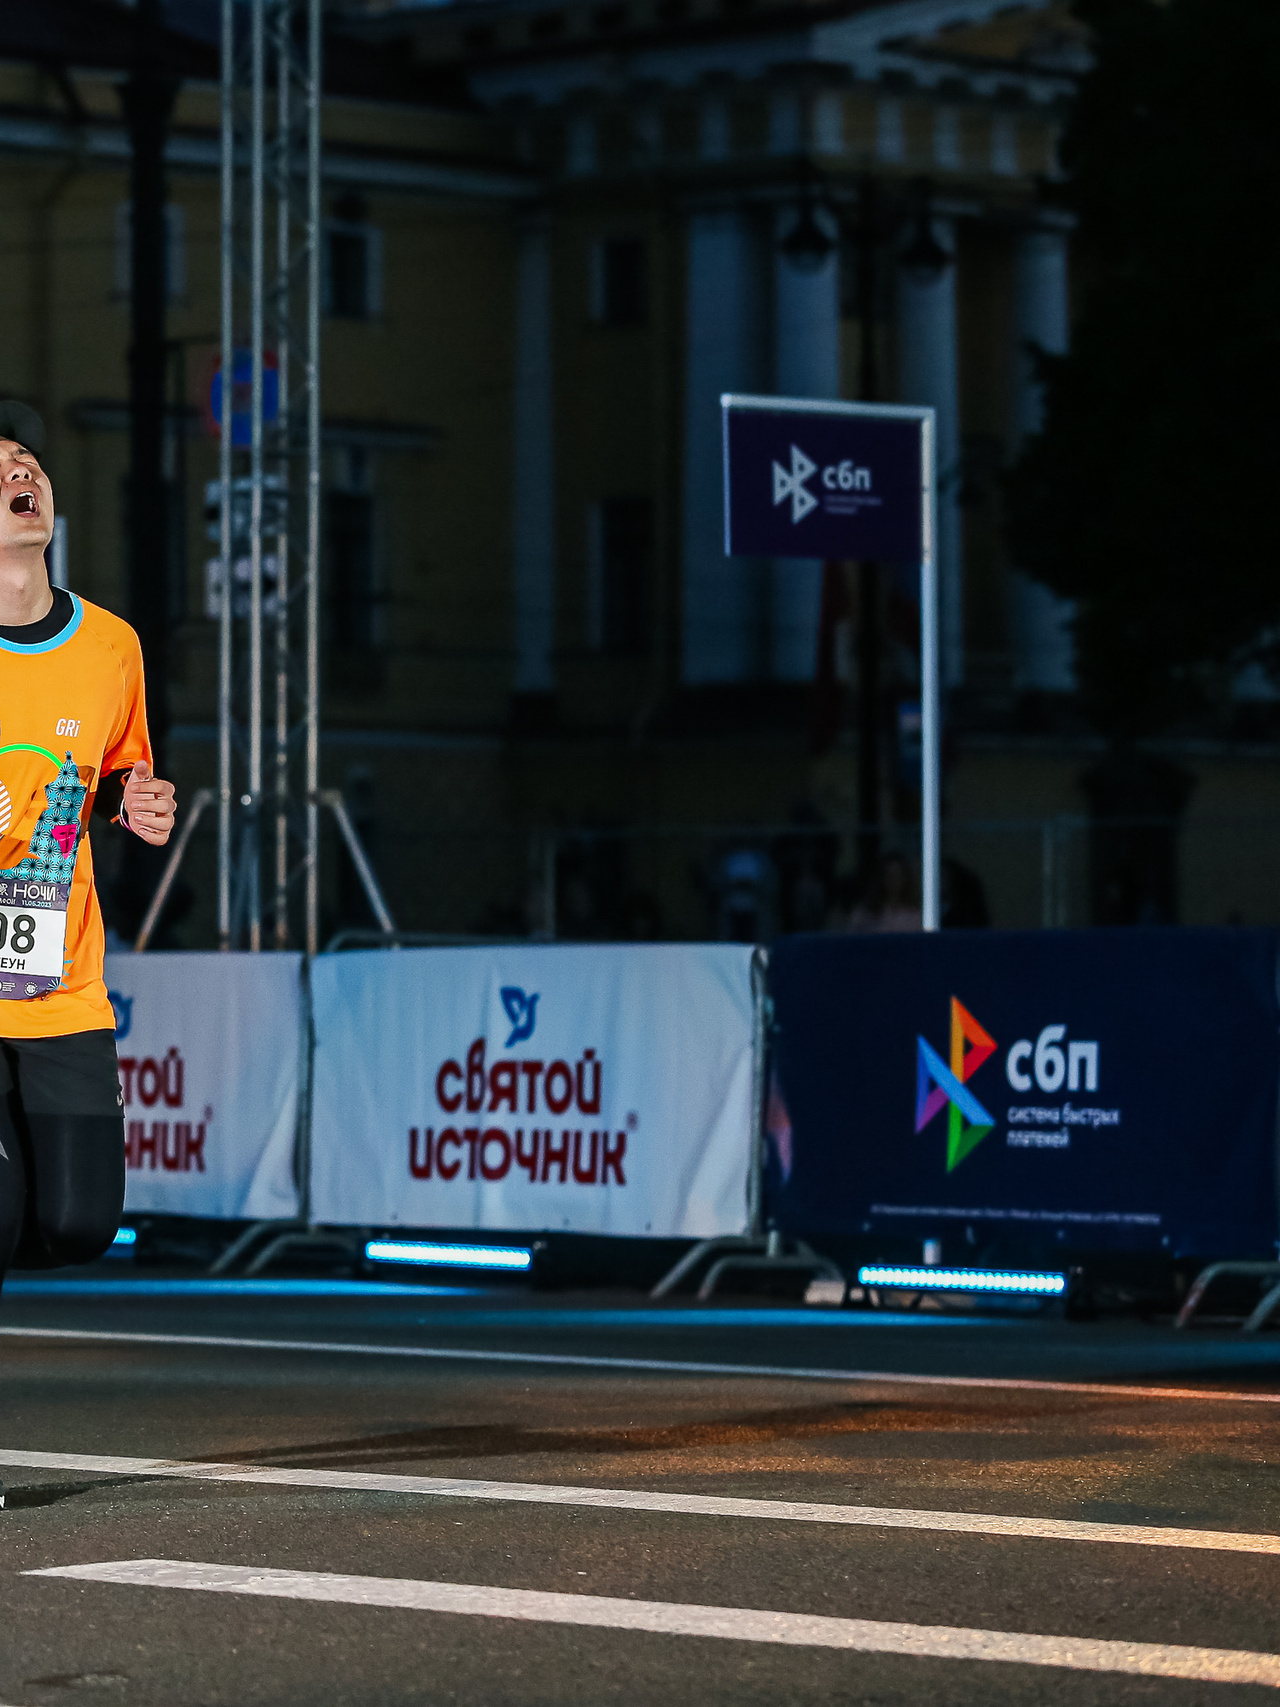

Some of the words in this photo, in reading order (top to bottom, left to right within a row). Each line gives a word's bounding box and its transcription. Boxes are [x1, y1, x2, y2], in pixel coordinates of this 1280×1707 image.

[821, 459, 872, 491] сбп
[55, 718, 81, 738] GRi
[13, 883, 57, 901] НОЧИ
[1006, 1023, 1100, 1093] сбп
